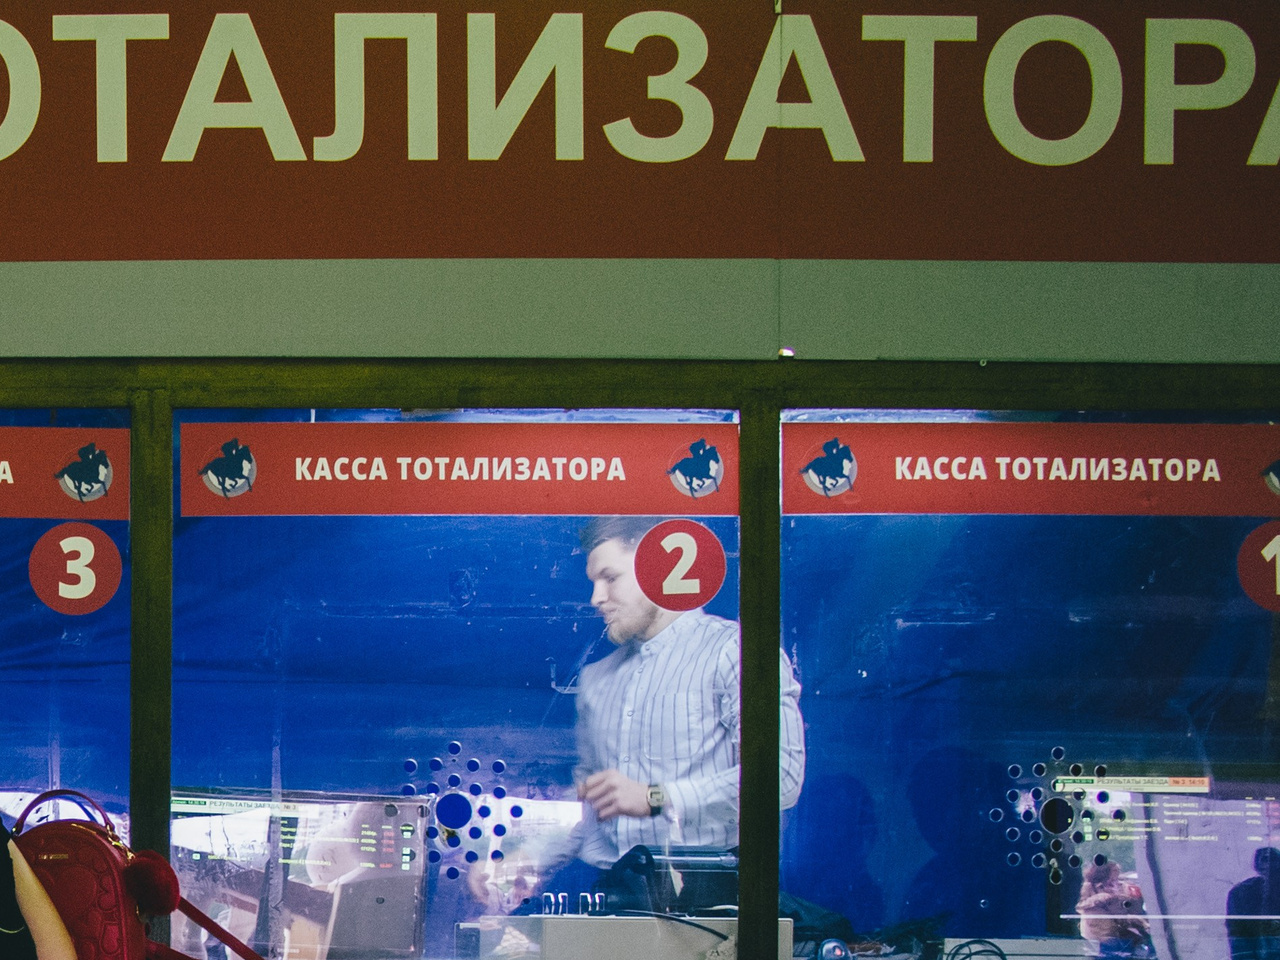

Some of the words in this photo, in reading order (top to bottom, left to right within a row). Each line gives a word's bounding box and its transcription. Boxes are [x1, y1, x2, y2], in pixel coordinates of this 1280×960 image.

[295, 456, 388, 481] КАССА
[396, 456, 626, 481] ТОТАЛИЗАТОРА
[895, 456, 988, 481] КАССА
[994, 456, 1221, 482] ТОТАЛИЗАТОРА
[58, 536, 97, 600] 3
[660, 531, 701, 595] 2
